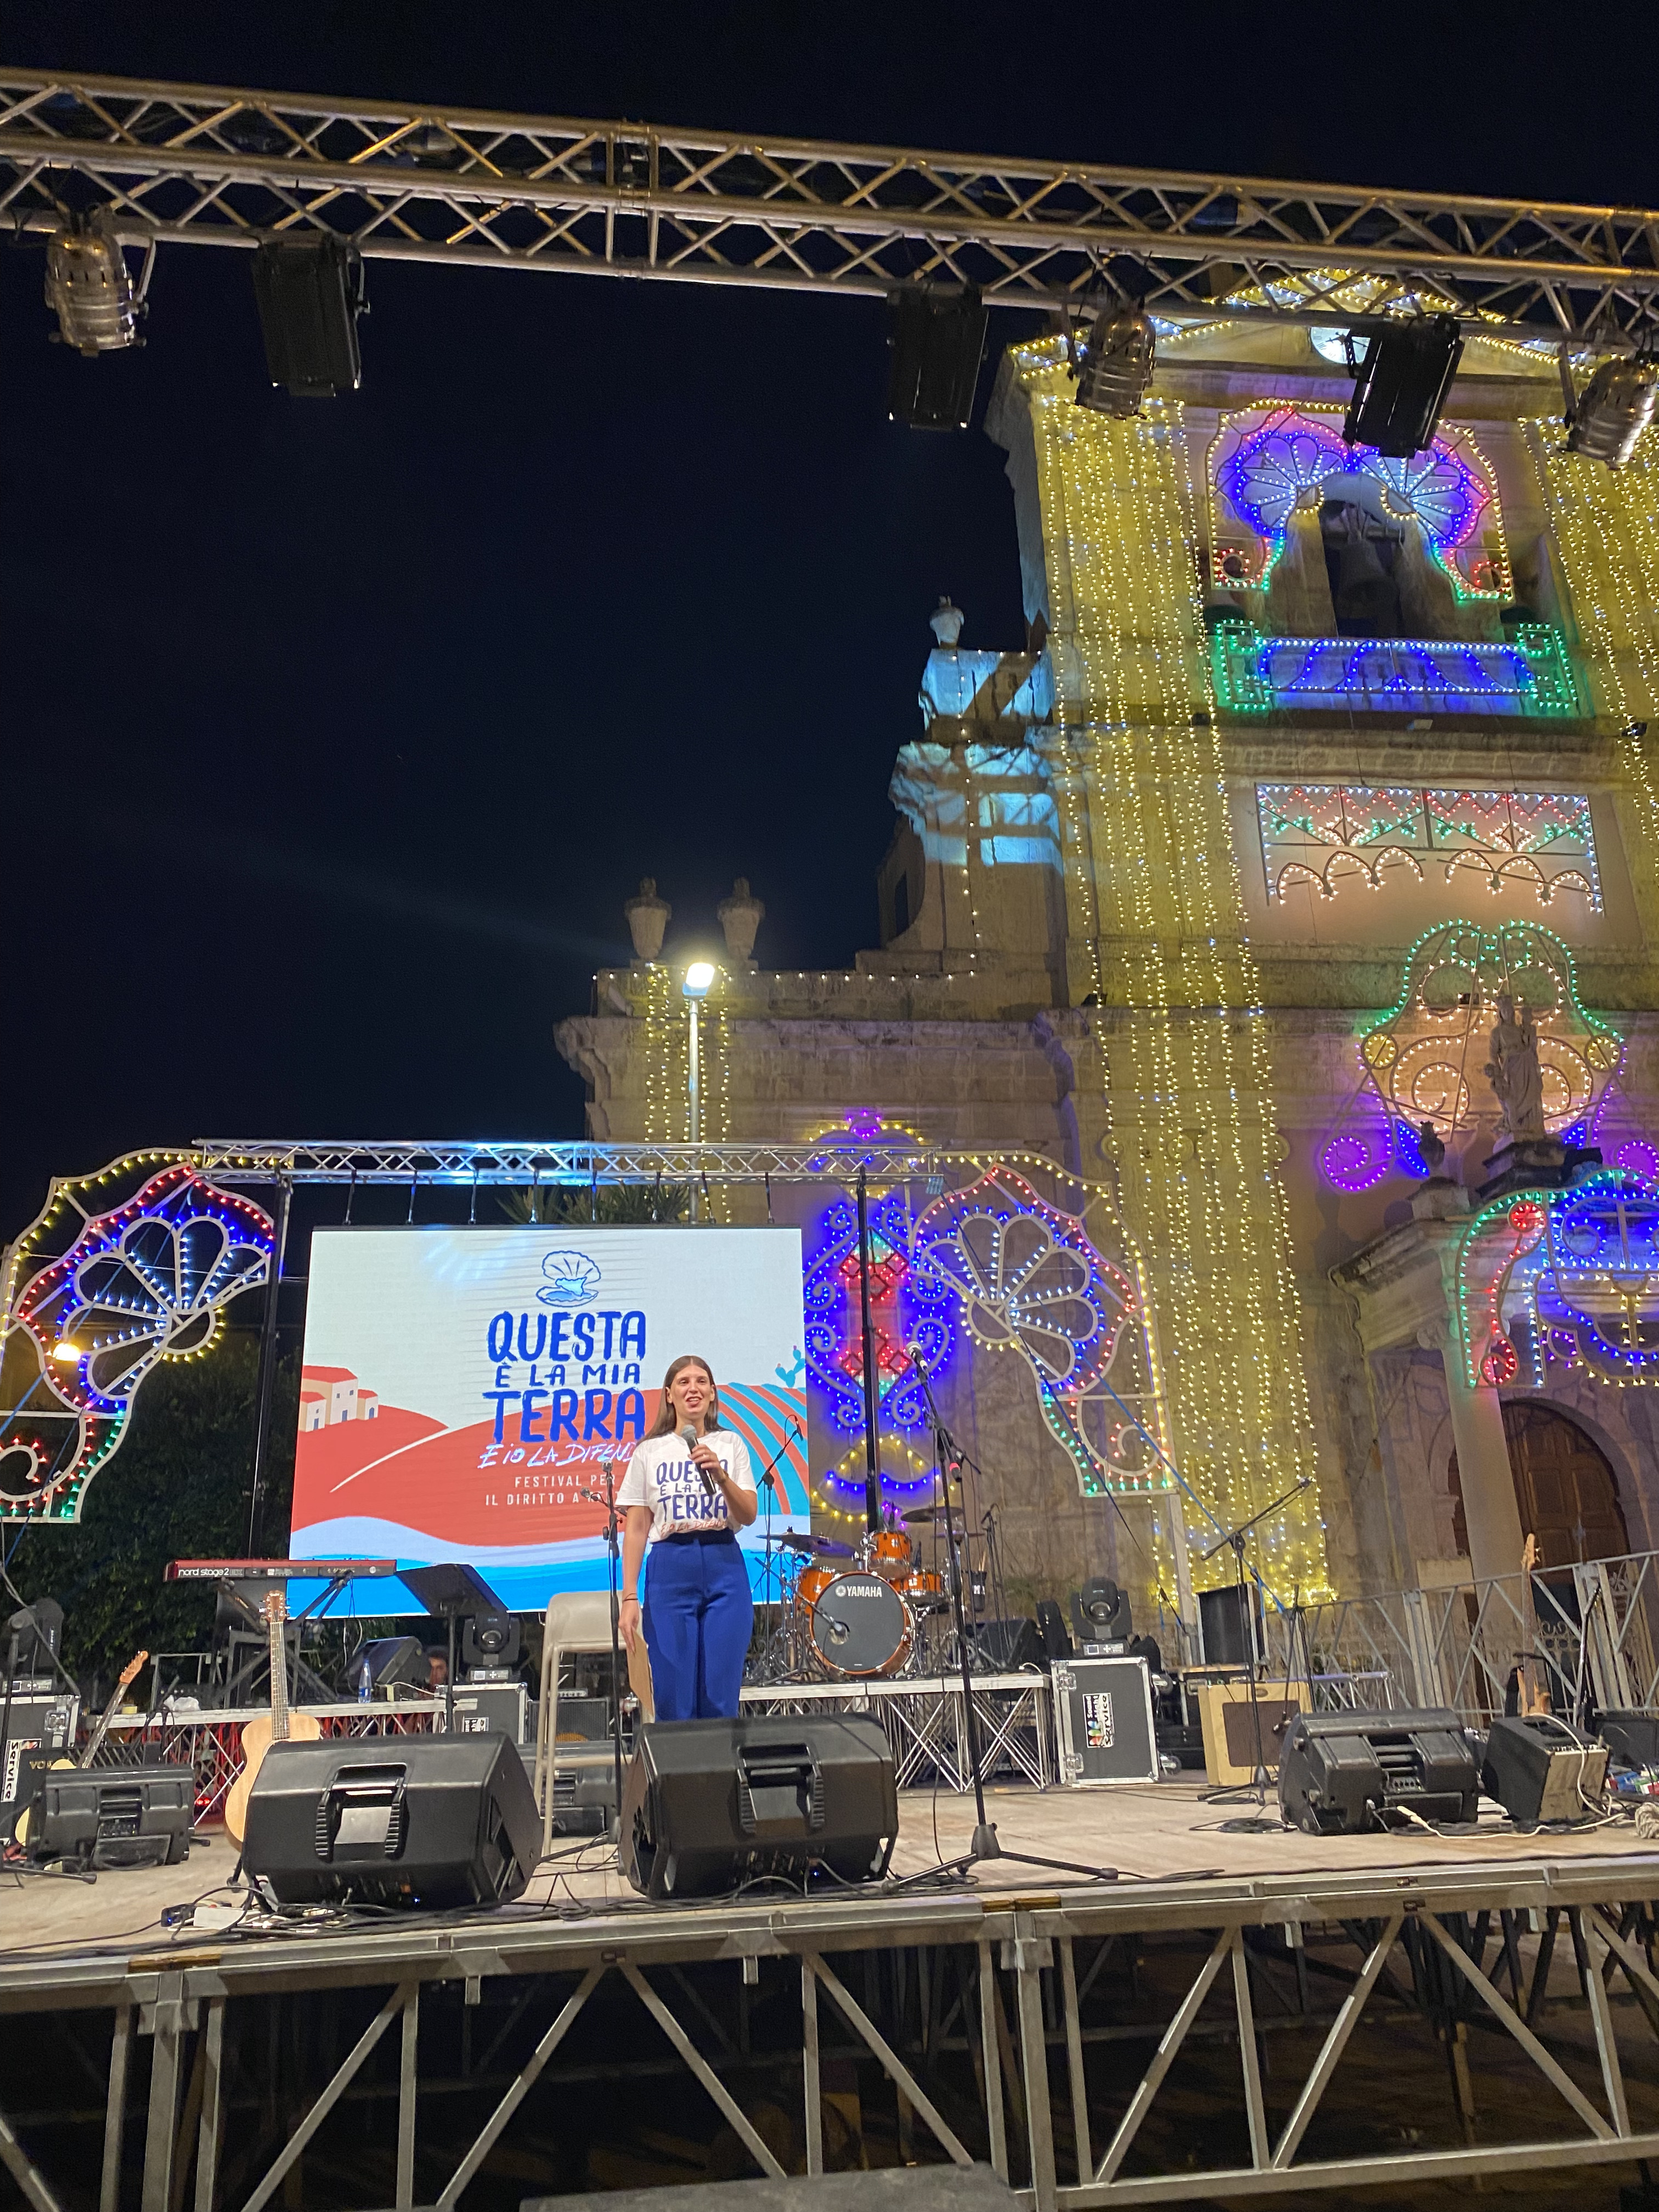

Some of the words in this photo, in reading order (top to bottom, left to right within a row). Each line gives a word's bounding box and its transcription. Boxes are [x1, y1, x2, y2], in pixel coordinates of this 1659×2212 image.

[487, 1311, 646, 1363] QUESTA
[495, 1362, 512, 1387] È
[529, 1364, 566, 1386] LA
[582, 1363, 640, 1385] MIA
[482, 1387, 646, 1444] TERRA
[527, 1445, 558, 1467] LA
[555, 1442, 636, 1467] DIFEND
[515, 1475, 582, 1488] FESTIVAL
[656, 1459, 728, 1485] QUESA
[486, 1494, 498, 1505] IL
[507, 1492, 565, 1505] DIRITTO
[572, 1492, 579, 1503] A
[675, 1483, 691, 1493] LA
[657, 1494, 728, 1522] TERRA
[200, 1568, 223, 1577] stage
[223, 1567, 229, 1576] 2
[847, 1585, 882, 1598] YAMAHA
[1102, 1695, 1111, 1745] Service
[5, 1741, 19, 1799] Service
